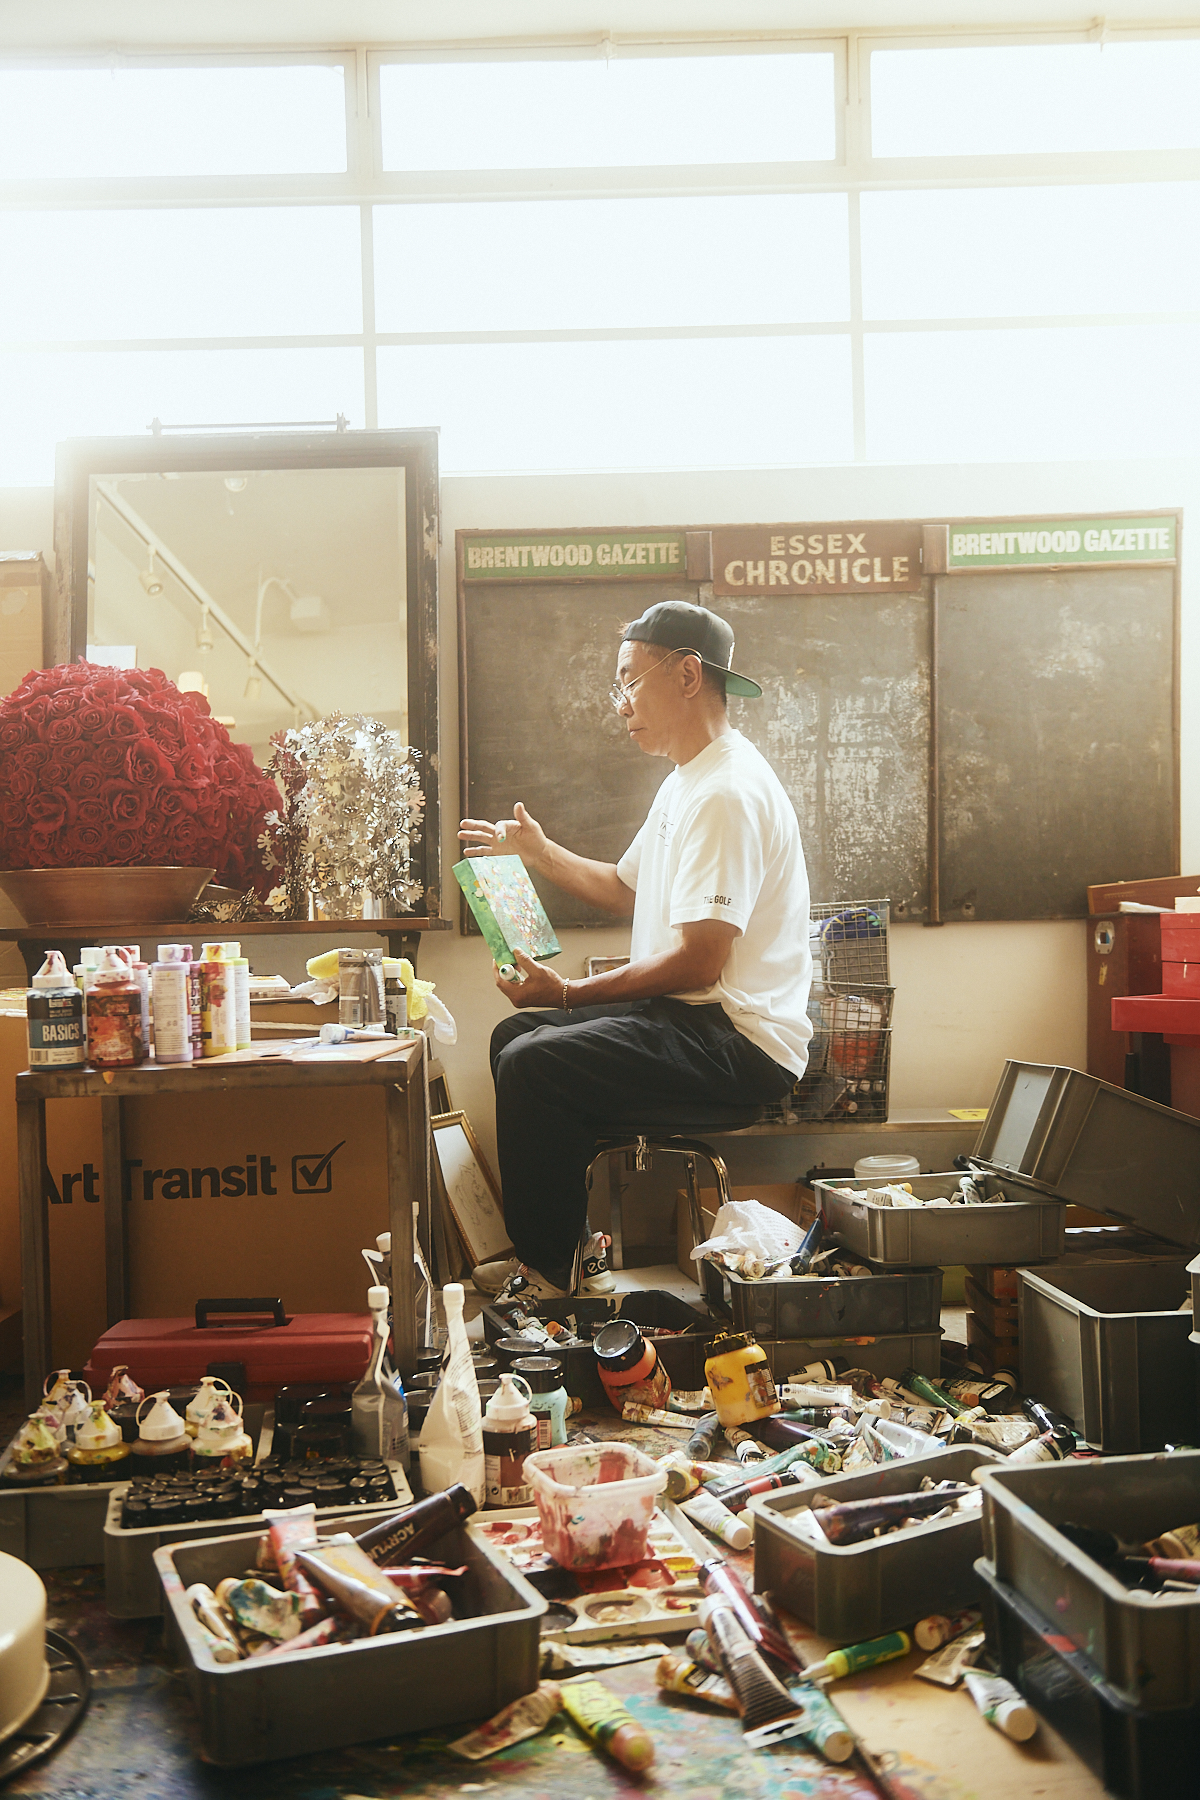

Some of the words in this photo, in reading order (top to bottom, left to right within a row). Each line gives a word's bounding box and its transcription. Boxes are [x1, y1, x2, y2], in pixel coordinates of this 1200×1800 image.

[467, 542, 593, 568] BRENTWOOD
[596, 542, 680, 565] GAZETTE
[770, 532, 867, 557] ESSEX
[952, 530, 1080, 556] BRENTWOOD
[1083, 527, 1170, 553] GAZETTE
[723, 556, 910, 586] CHRONICLE
[122, 1155, 278, 1202] Transit
